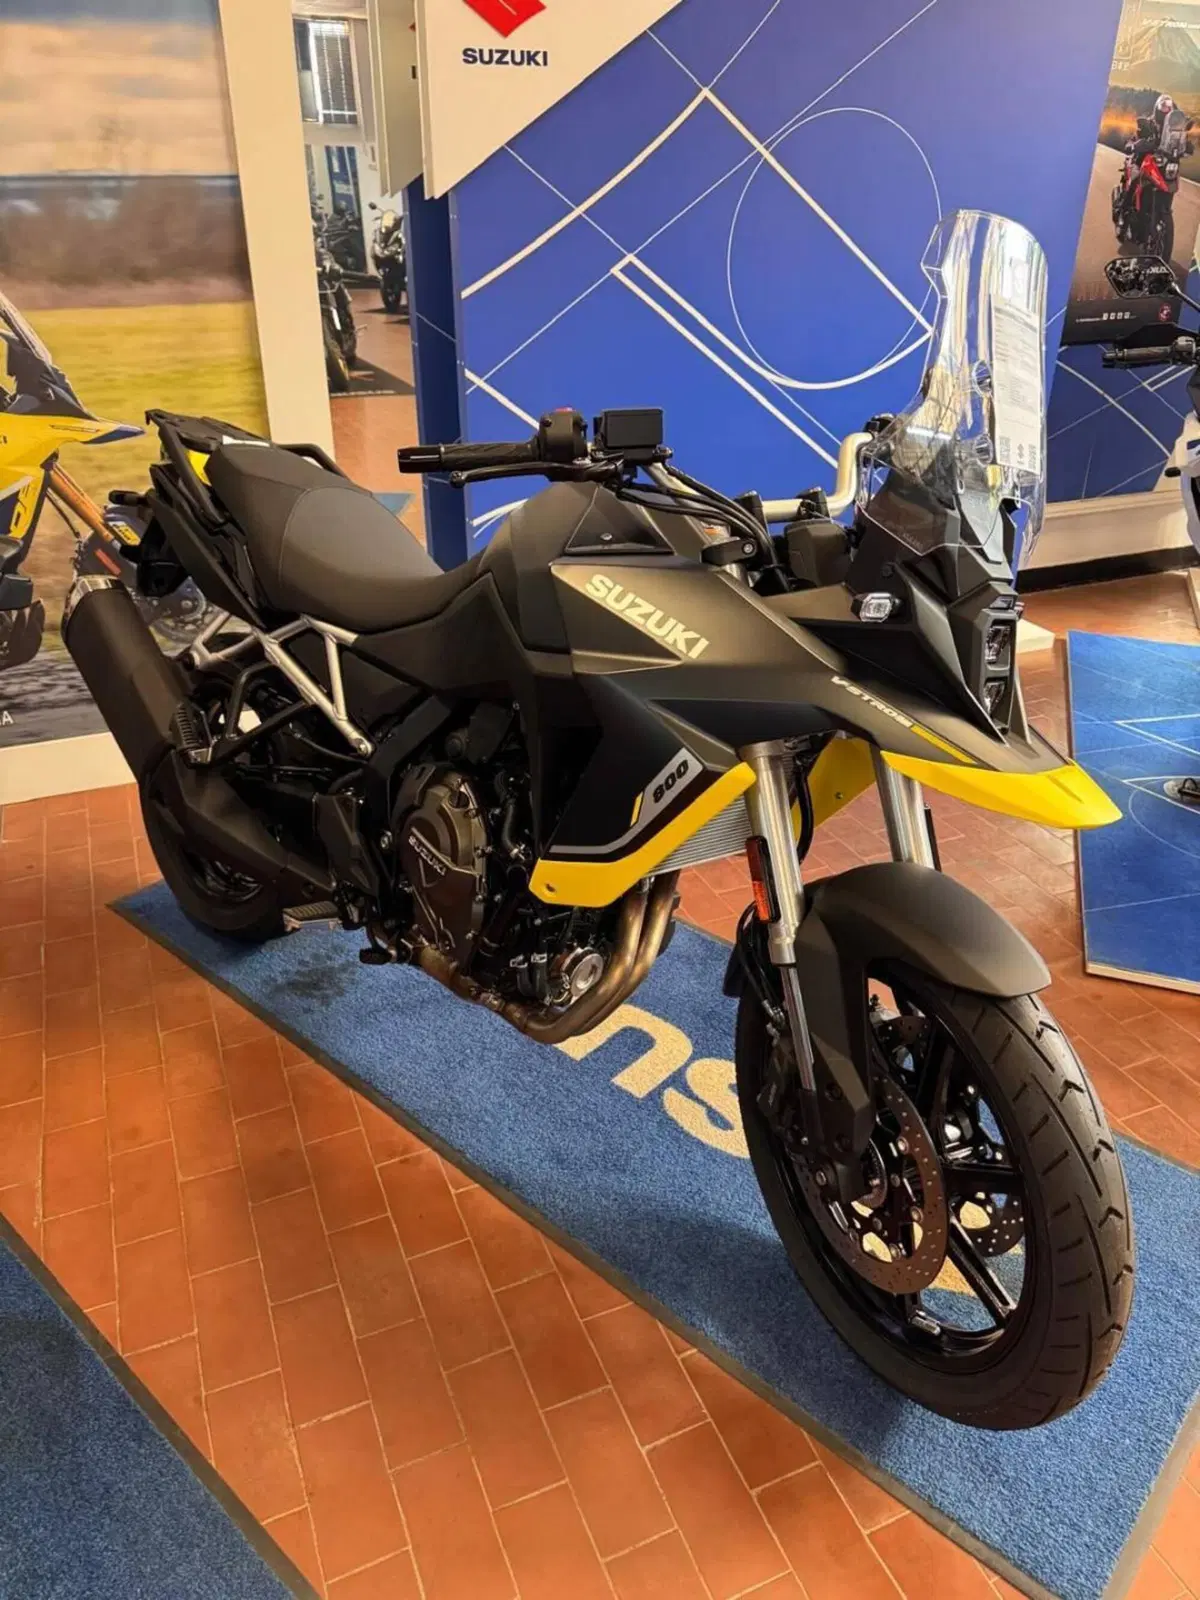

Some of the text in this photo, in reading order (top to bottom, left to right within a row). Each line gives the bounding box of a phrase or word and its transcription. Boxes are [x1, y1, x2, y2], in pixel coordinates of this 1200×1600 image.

[462, 47, 548, 66] SUZUKI
[585, 574, 710, 659] SUZUKI
[652, 759, 689, 804] 800
[408, 835, 447, 876] SUZUKI
